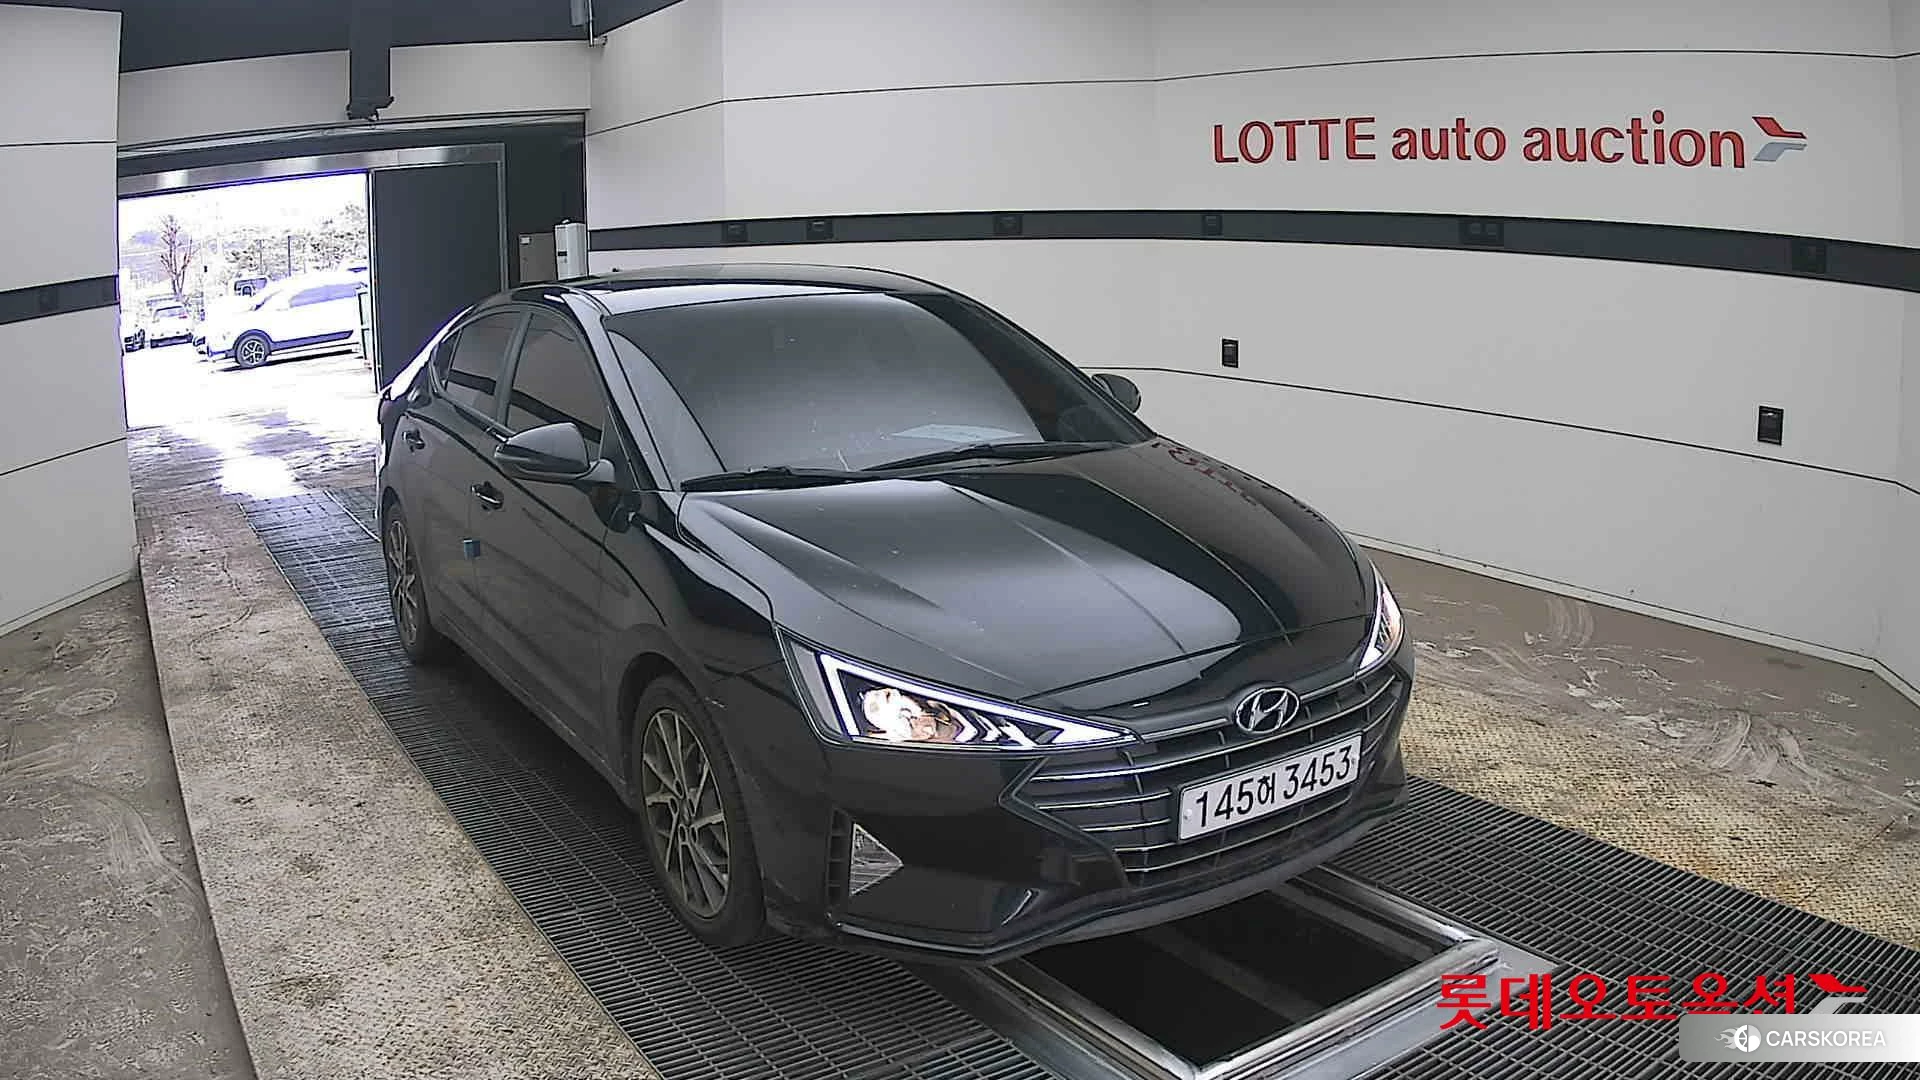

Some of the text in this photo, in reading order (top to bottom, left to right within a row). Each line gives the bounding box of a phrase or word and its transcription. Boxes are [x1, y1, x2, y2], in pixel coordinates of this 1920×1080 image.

[1213, 109, 1746, 169] LOTTE auto auction
[1195, 745, 1352, 827] 145허 3453
